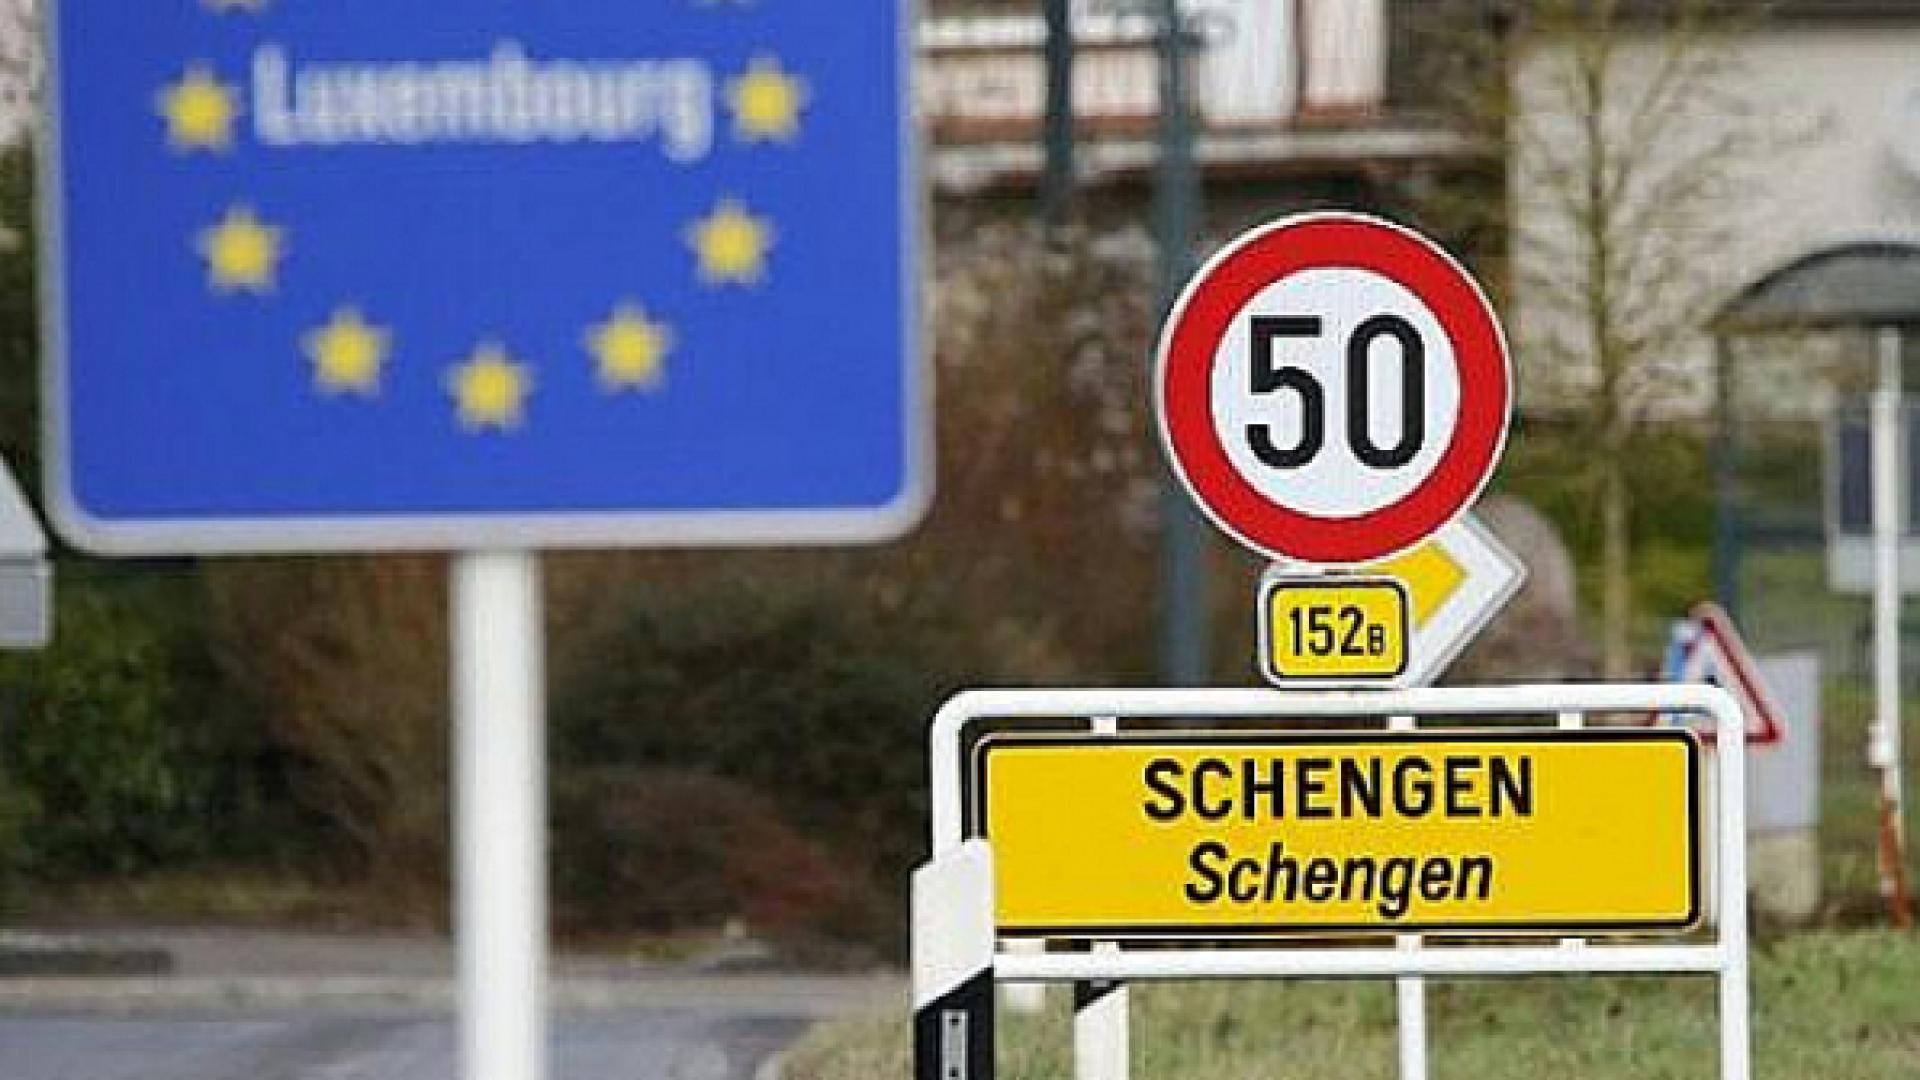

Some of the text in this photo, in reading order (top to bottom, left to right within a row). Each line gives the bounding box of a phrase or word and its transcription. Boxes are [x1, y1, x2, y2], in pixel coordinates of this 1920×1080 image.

[251, 42, 714, 161] Luxembourg
[1244, 314, 1426, 470] 50
[1143, 756, 1534, 820] SCHENGEN
[1185, 841, 1493, 917] Schengen
